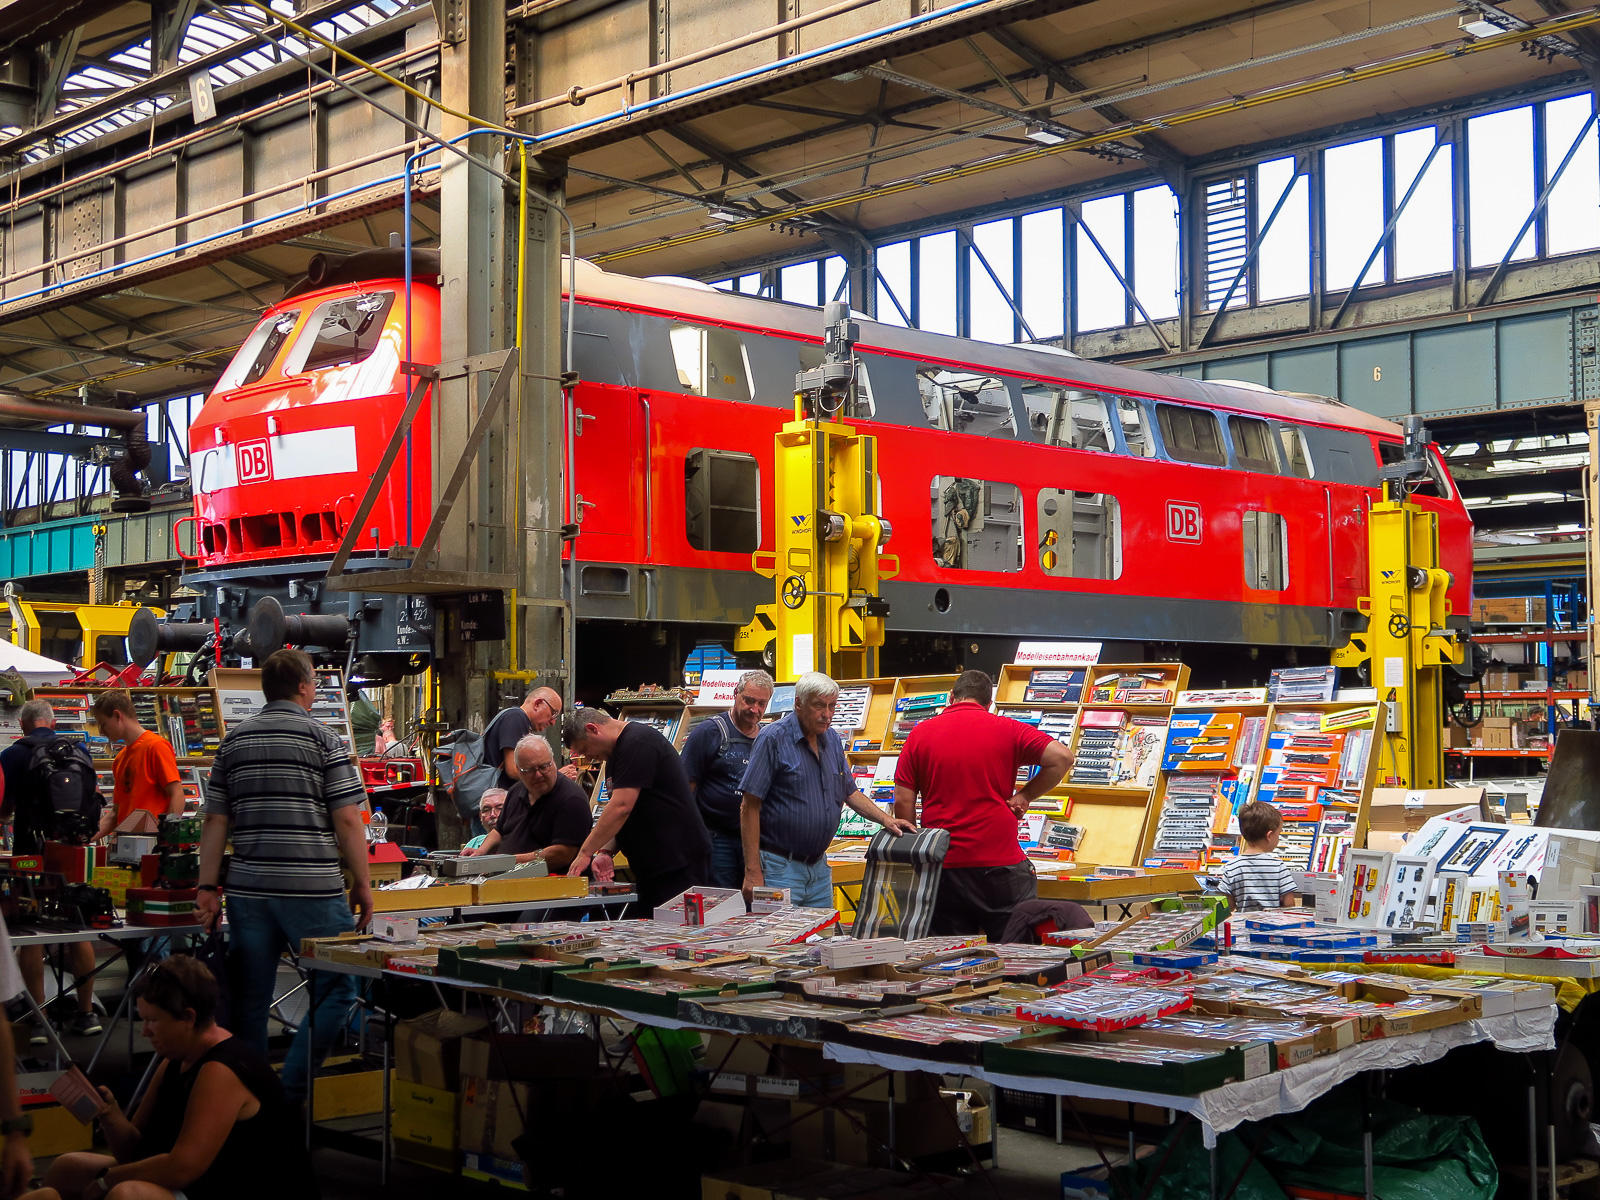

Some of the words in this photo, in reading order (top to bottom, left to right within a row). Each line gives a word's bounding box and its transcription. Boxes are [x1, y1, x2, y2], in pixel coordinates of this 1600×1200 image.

[196, 77, 209, 113] 6
[1373, 366, 1382, 382] 6
[241, 446, 266, 477] DB
[1171, 507, 1197, 536] DB
[158, 528, 162, 537] 2
[1016, 651, 1098, 663] Modelleisenbahnankauf
[1181, 927, 1199, 944] ORKI
[1507, 947, 1527, 955] duplo
[979, 960, 999, 971] GERMANY
[1391, 1021, 1409, 1032] Azura
[1294, 1047, 1313, 1060] Azura
